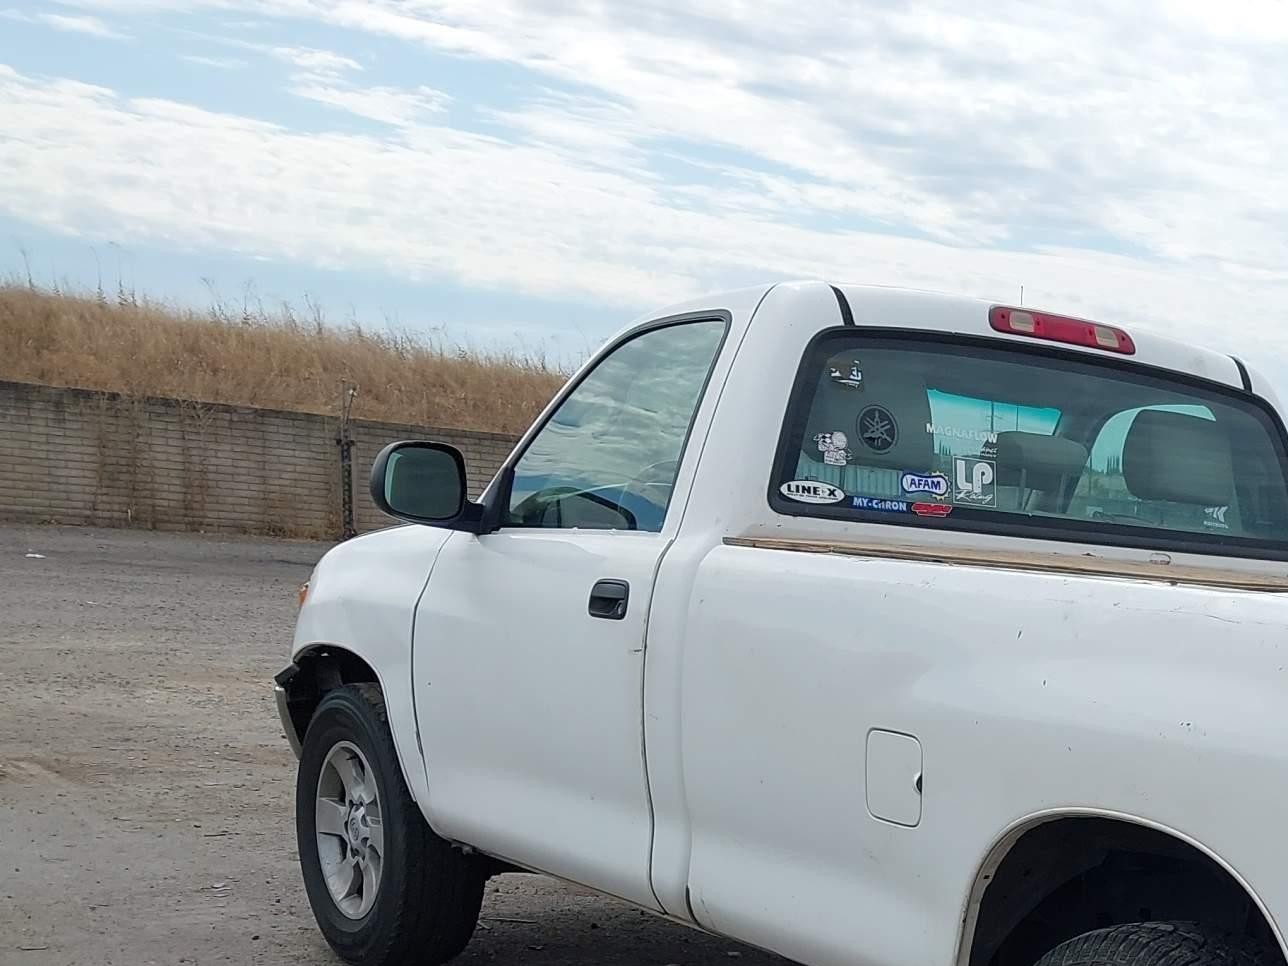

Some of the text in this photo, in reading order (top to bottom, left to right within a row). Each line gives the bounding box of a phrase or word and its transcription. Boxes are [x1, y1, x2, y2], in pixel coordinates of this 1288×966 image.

[926, 423, 998, 444] MAGNAFLOW
[910, 478, 941, 491] AFAM
[956, 459, 993, 493] LP
